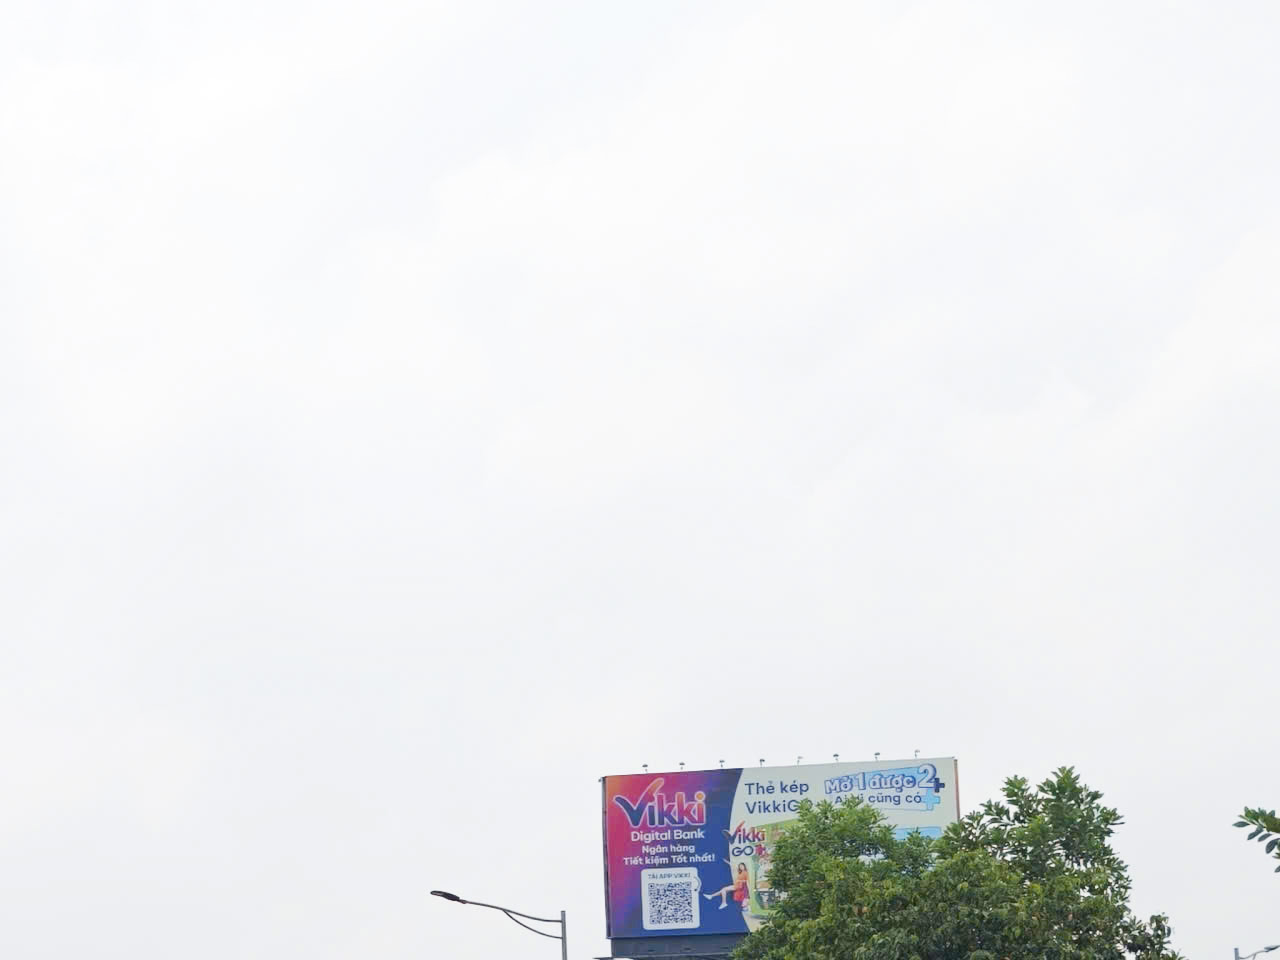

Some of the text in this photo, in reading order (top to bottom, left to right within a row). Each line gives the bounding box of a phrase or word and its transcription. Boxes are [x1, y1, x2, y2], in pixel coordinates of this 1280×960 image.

[744, 780, 810, 796] Thẻ kép
[824, 776, 853, 794] Mở
[856, 772, 867, 790] 1
[869, 774, 917, 793] được
[613, 777, 706, 828] Vikki
[868, 792, 901, 806] cũng
[905, 792, 922, 804] có
[631, 828, 705, 844] Digital Bank
[641, 843, 696, 856] Ngân hàng
[623, 855, 643, 866] Tiết
[644, 855, 669, 867] kiệm
[670, 853, 688, 864] Tốt
